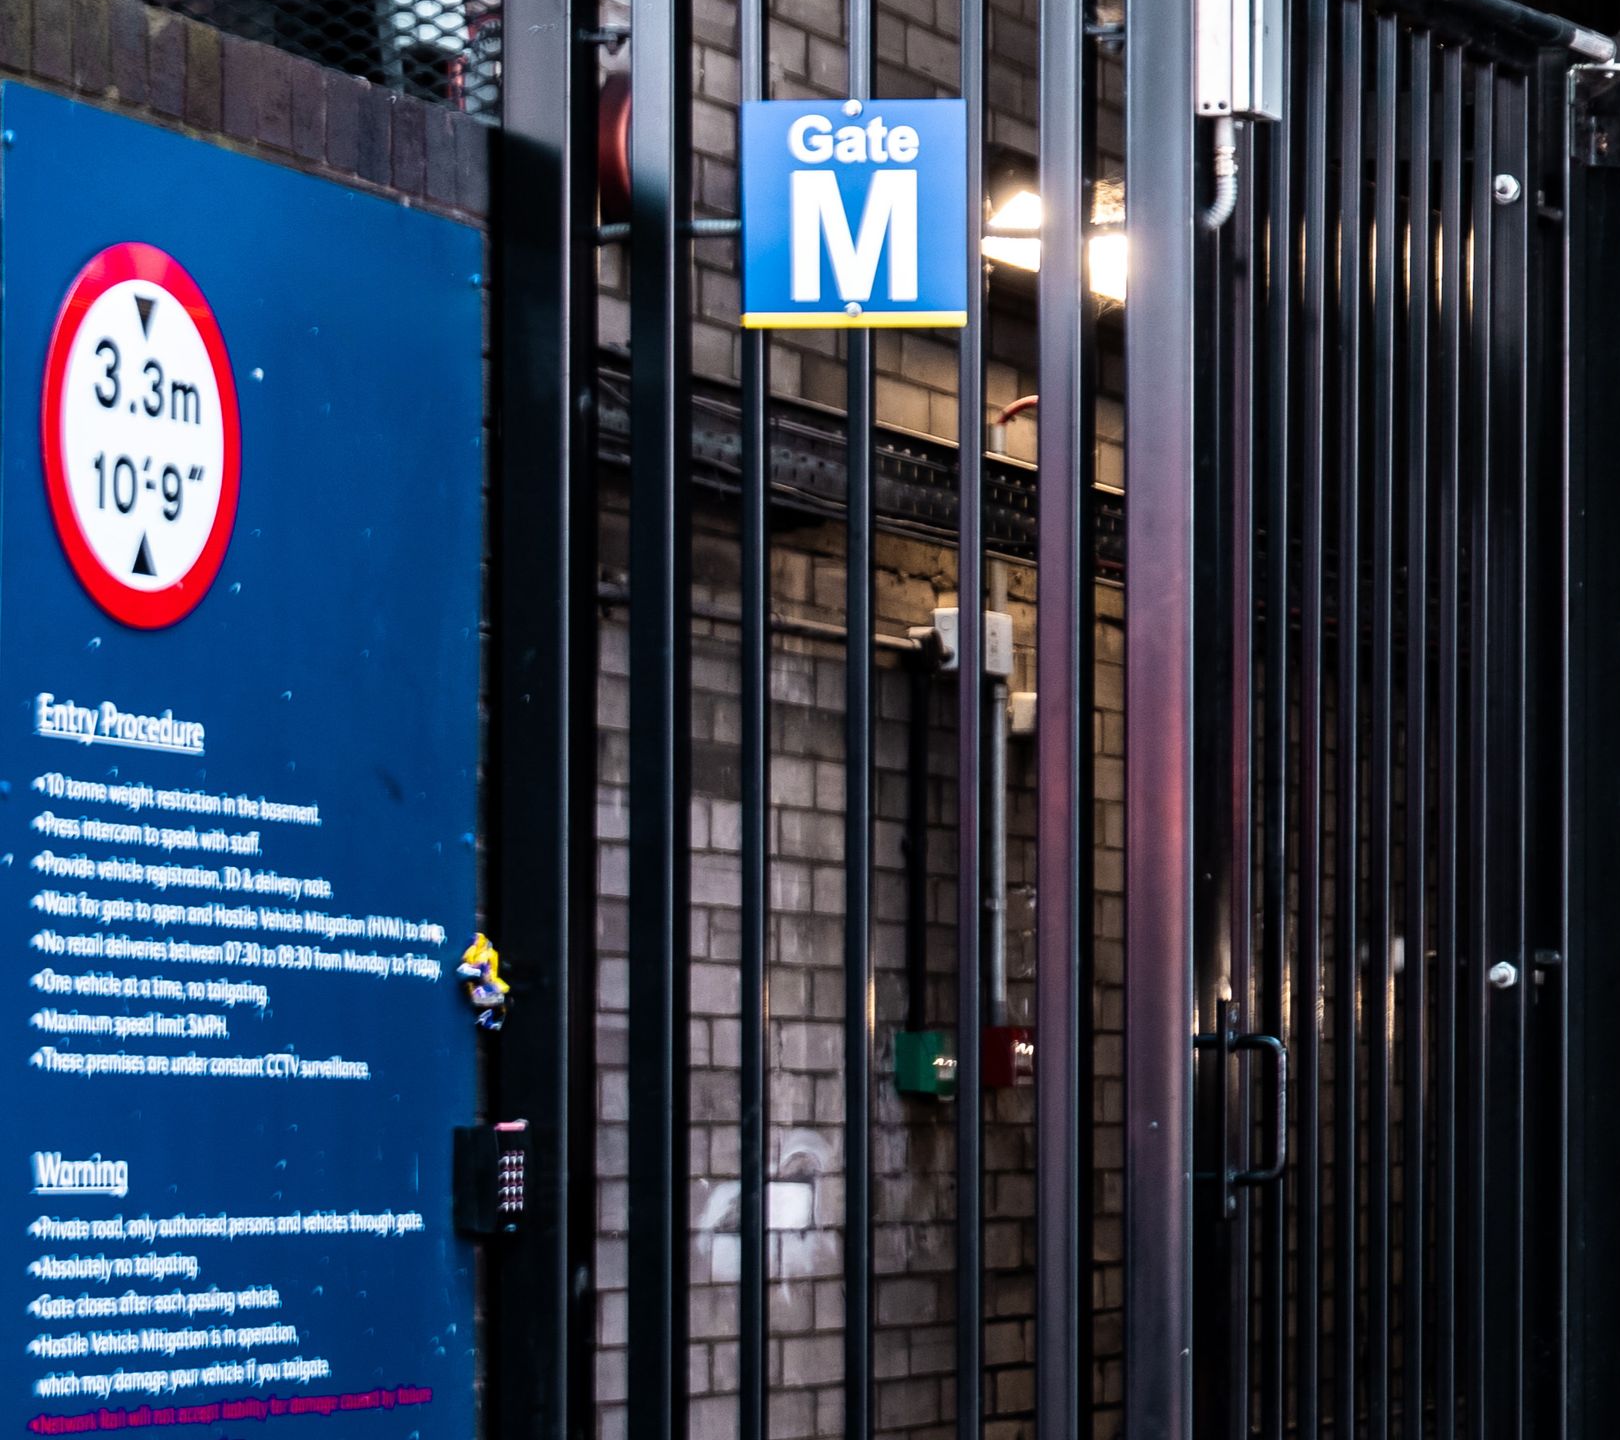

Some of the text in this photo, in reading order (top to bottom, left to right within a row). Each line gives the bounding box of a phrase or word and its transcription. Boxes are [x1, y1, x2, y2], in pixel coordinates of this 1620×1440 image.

[789, 114, 919, 164] Gate
[790, 169, 918, 302] M
[94, 337, 202, 426] 3.3m
[36, 693, 205, 750] Entry Procedure
[65, 779, 106, 802] tonne
[107, 785, 153, 811] weight
[155, 789, 220, 813] restriction
[236, 796, 258, 818] the
[43, 811, 79, 838] Press
[80, 821, 141, 844] intercom
[159, 828, 198, 851] speak
[199, 830, 227, 852] with
[43, 850, 93, 878] Provide
[95, 859, 143, 882] vehicle
[144, 865, 221, 890] registration,
[253, 872, 300, 900] delivery
[42, 890, 77, 916] Wait
[77, 892, 99, 917] for
[98, 900, 132, 924] gate
[149, 904, 185, 926] open
[185, 904, 213, 925] and
[213, 904, 257, 928] Hostile
[258, 907, 302, 932] Vehicle
[302, 911, 365, 939] Mitigation
[42, 930, 65, 954] No
[66, 933, 103, 956] retail
[103, 935, 167, 960] deliveries
[167, 940, 223, 963] between
[311, 946, 341, 970] from
[341, 950, 391, 977] Monday
[41, 968, 72, 993] One
[73, 973, 121, 996] vehicle
[149, 977, 186, 1000] time,
[41, 1009, 112, 1033] Maximum
[112, 1014, 153, 1039] speed
[153, 1013, 186, 1037] limit
[40, 1047, 84, 1073] These
[84, 1054, 144, 1075] premises
[145, 1056, 169, 1074] are
[169, 1054, 209, 1075] under
[208, 1057, 263, 1076] constant
[262, 1054, 299, 1077] CCTV
[35, 1152, 128, 1197] Warning
[40, 1216, 90, 1239] Private
[124, 1216, 157, 1242] only
[155, 1214, 226, 1237] authorised
[224, 1214, 275, 1238] persons
[275, 1213, 301, 1233] and
[302, 1212, 350, 1233] vehicles
[349, 1212, 395, 1236] through
[40, 1255, 112, 1282] Absolutely
[74, 1295, 117, 1317] closes
[116, 1290, 151, 1314] after
[150, 1292, 184, 1313] each
[182, 1287, 235, 1316] passing
[40, 1333, 88, 1357] Hostile
[86, 1332, 139, 1354] Vehicle
[138, 1328, 207, 1355] Mitigation
[33, 1373, 79, 1396] which
[80, 1375, 111, 1397] may
[109, 1370, 168, 1394] damage
[165, 1369, 199, 1392] your
[199, 1364, 243, 1385] vehicle
[253, 1359, 280, 1386] you
